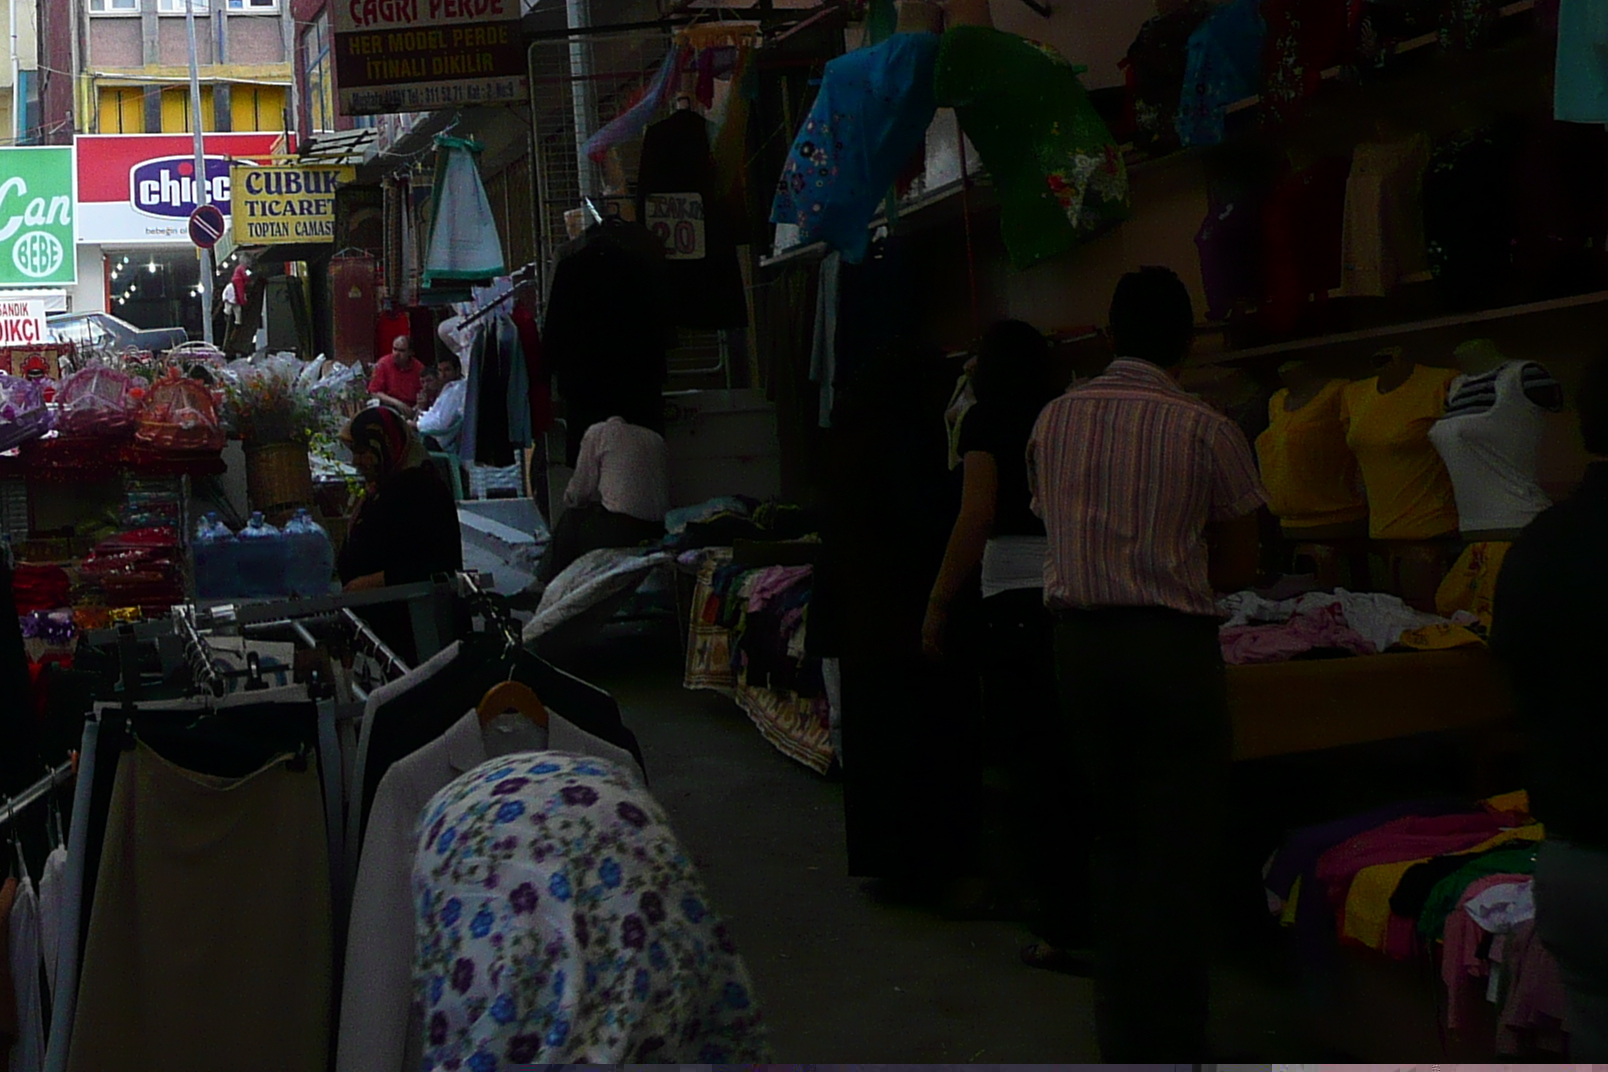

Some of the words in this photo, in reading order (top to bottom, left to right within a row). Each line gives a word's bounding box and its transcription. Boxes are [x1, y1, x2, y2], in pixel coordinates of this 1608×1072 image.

[349, 36, 383, 55] HER
[388, 31, 448, 52] MODEL
[453, 25, 509, 47] PERDE
[366, 55, 427, 80] İTİNALI
[432, 48, 495, 75] DİKİLİR
[139, 162, 230, 207] chicc
[245, 171, 341, 195] CUBUK
[247, 222, 289, 237] TOPTAN
[652, 221, 695, 254] 20
[18, 234, 59, 274] BEBE
